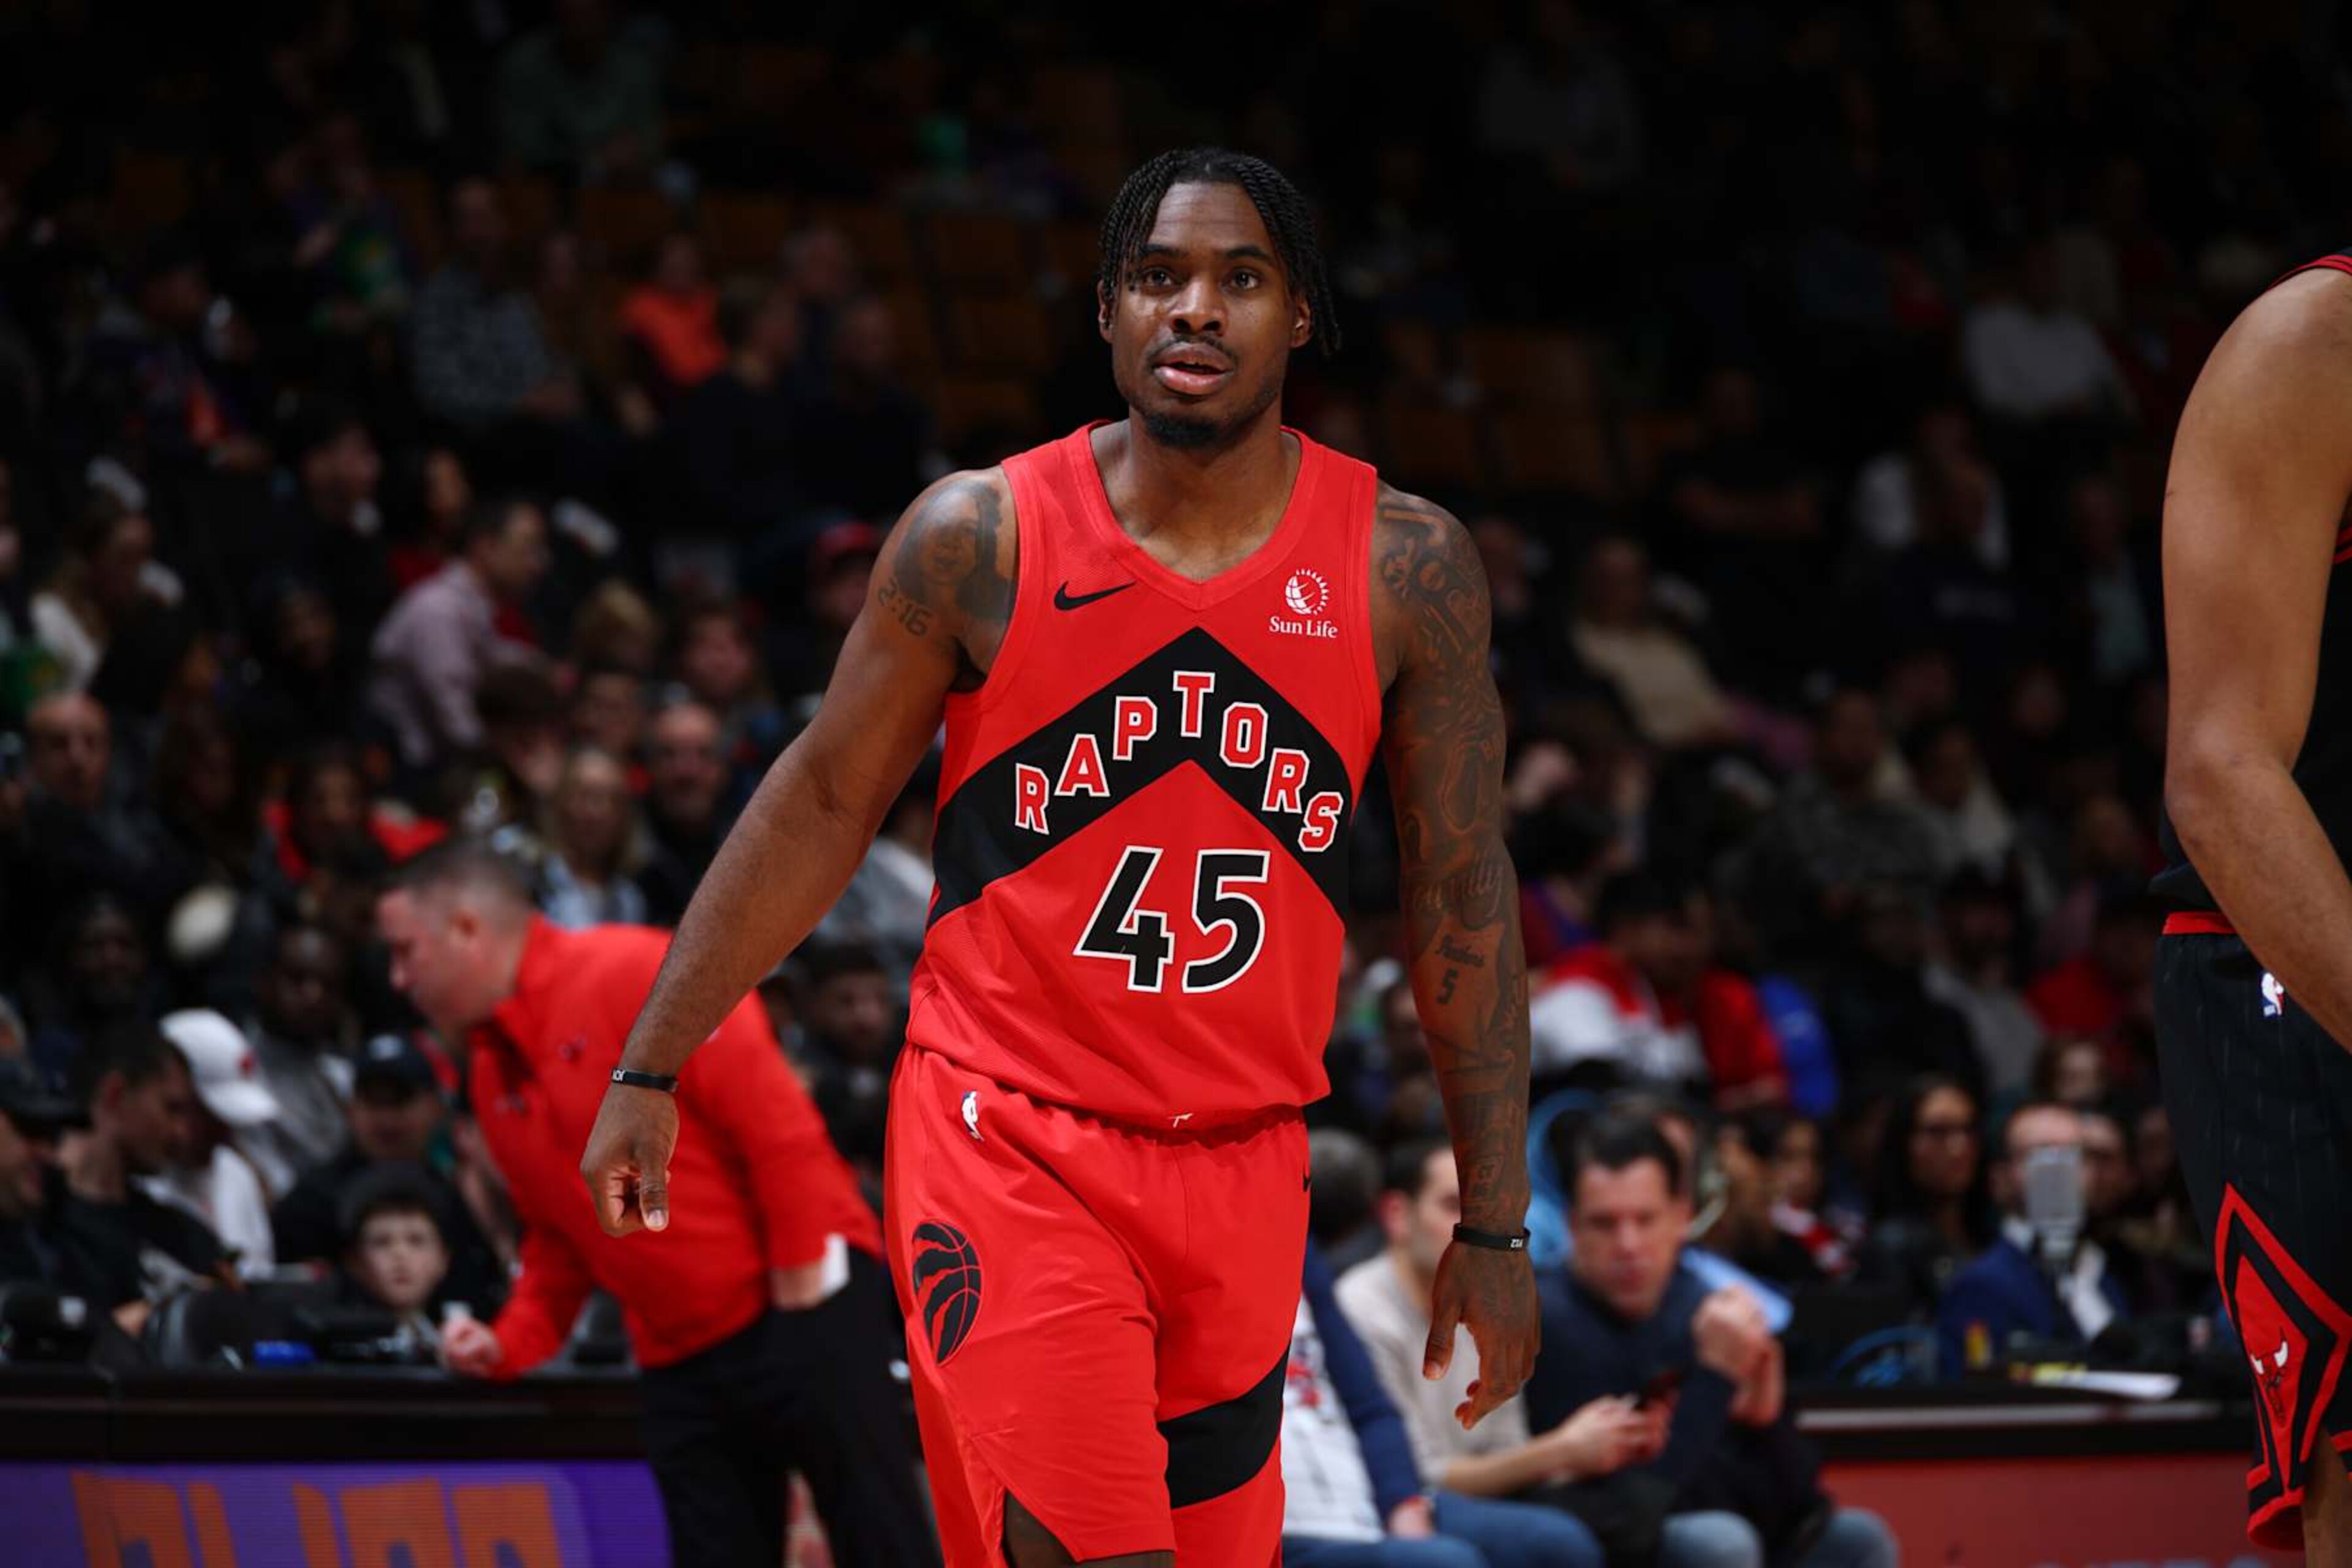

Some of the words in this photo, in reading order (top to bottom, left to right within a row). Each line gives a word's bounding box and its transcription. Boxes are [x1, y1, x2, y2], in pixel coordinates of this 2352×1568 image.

[1269, 616, 1303, 635] Sun
[1306, 619, 1338, 638] Life
[1014, 670, 1344, 853] RAPTORS
[1072, 845, 1271, 994] 45
